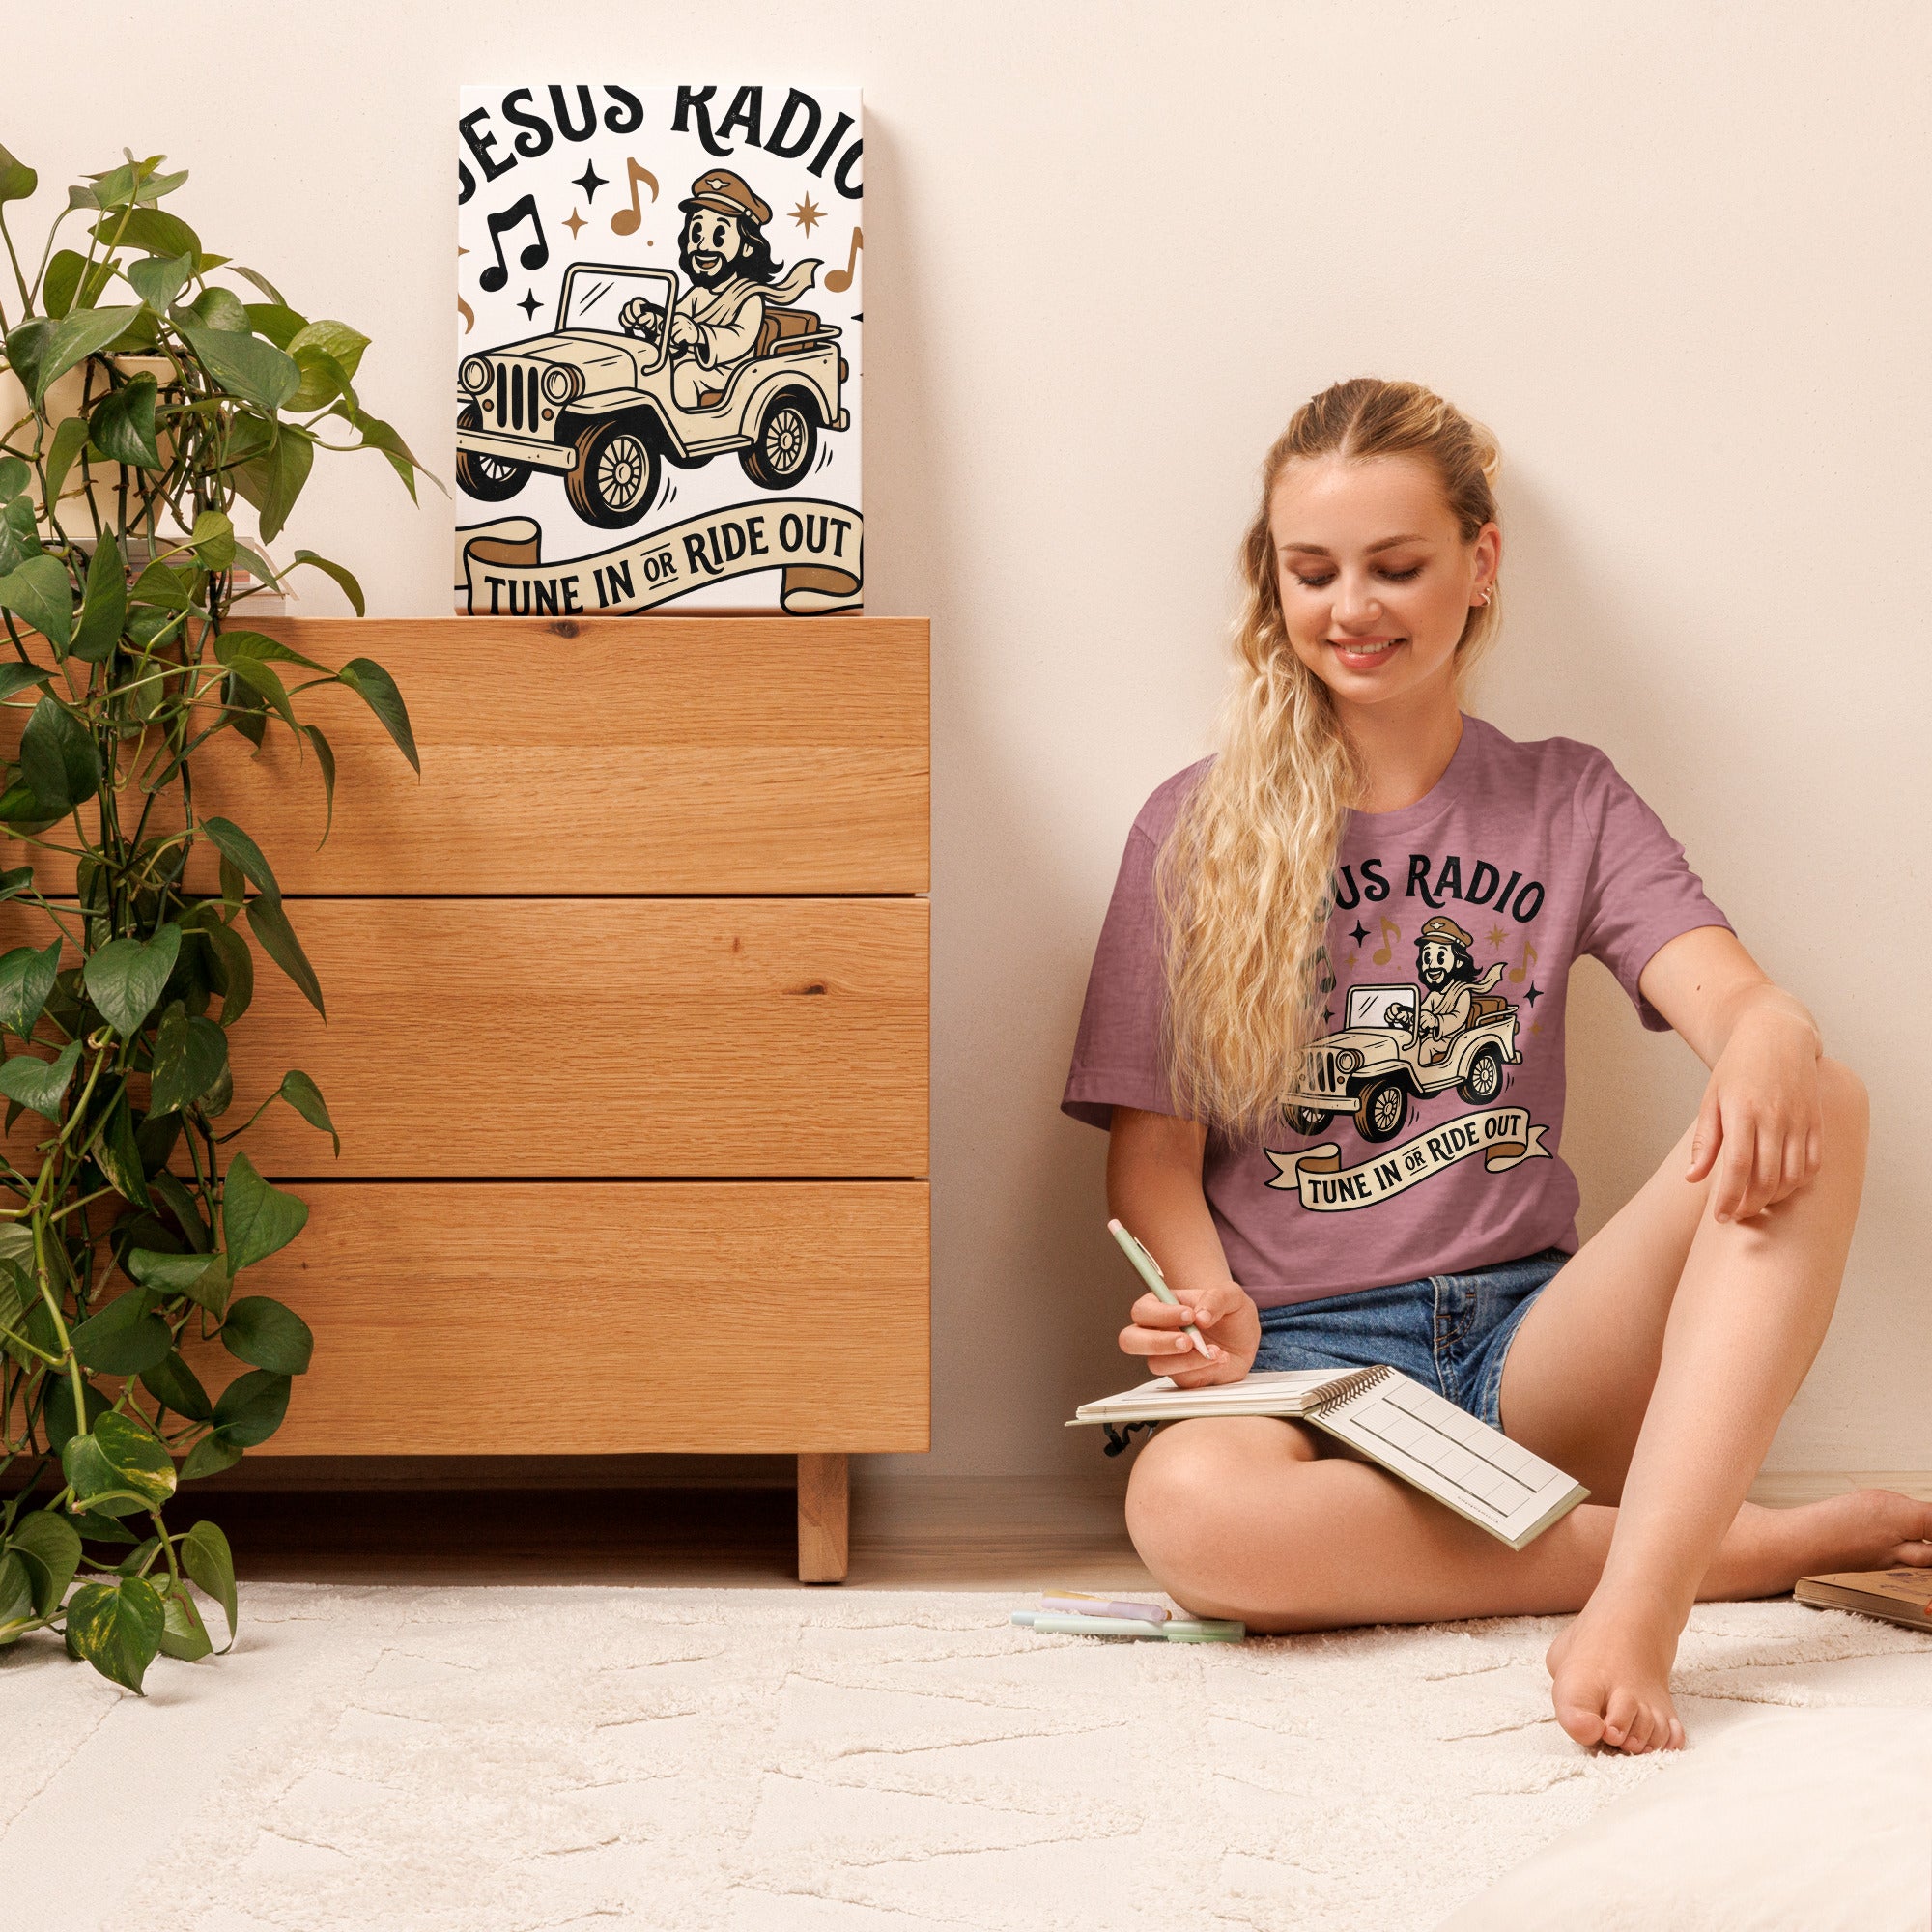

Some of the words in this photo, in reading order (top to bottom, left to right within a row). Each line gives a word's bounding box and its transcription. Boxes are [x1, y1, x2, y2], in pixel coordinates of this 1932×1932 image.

[670, 85, 864, 200] RADIO
[484, 575, 584, 616] TUNE
[592, 559, 636, 609] IN
[643, 552, 677, 582] OR
[682, 515, 769, 575] RIDE
[779, 513, 852, 558] OUT
[1405, 854, 1546, 923] RADIO
[1307, 1172, 1373, 1204] TUNE
[1377, 1159, 1403, 1191] IN
[1405, 1151, 1427, 1171] OR
[1426, 1122, 1480, 1163] RIDE
[1484, 1114, 1522, 1140] OUT
